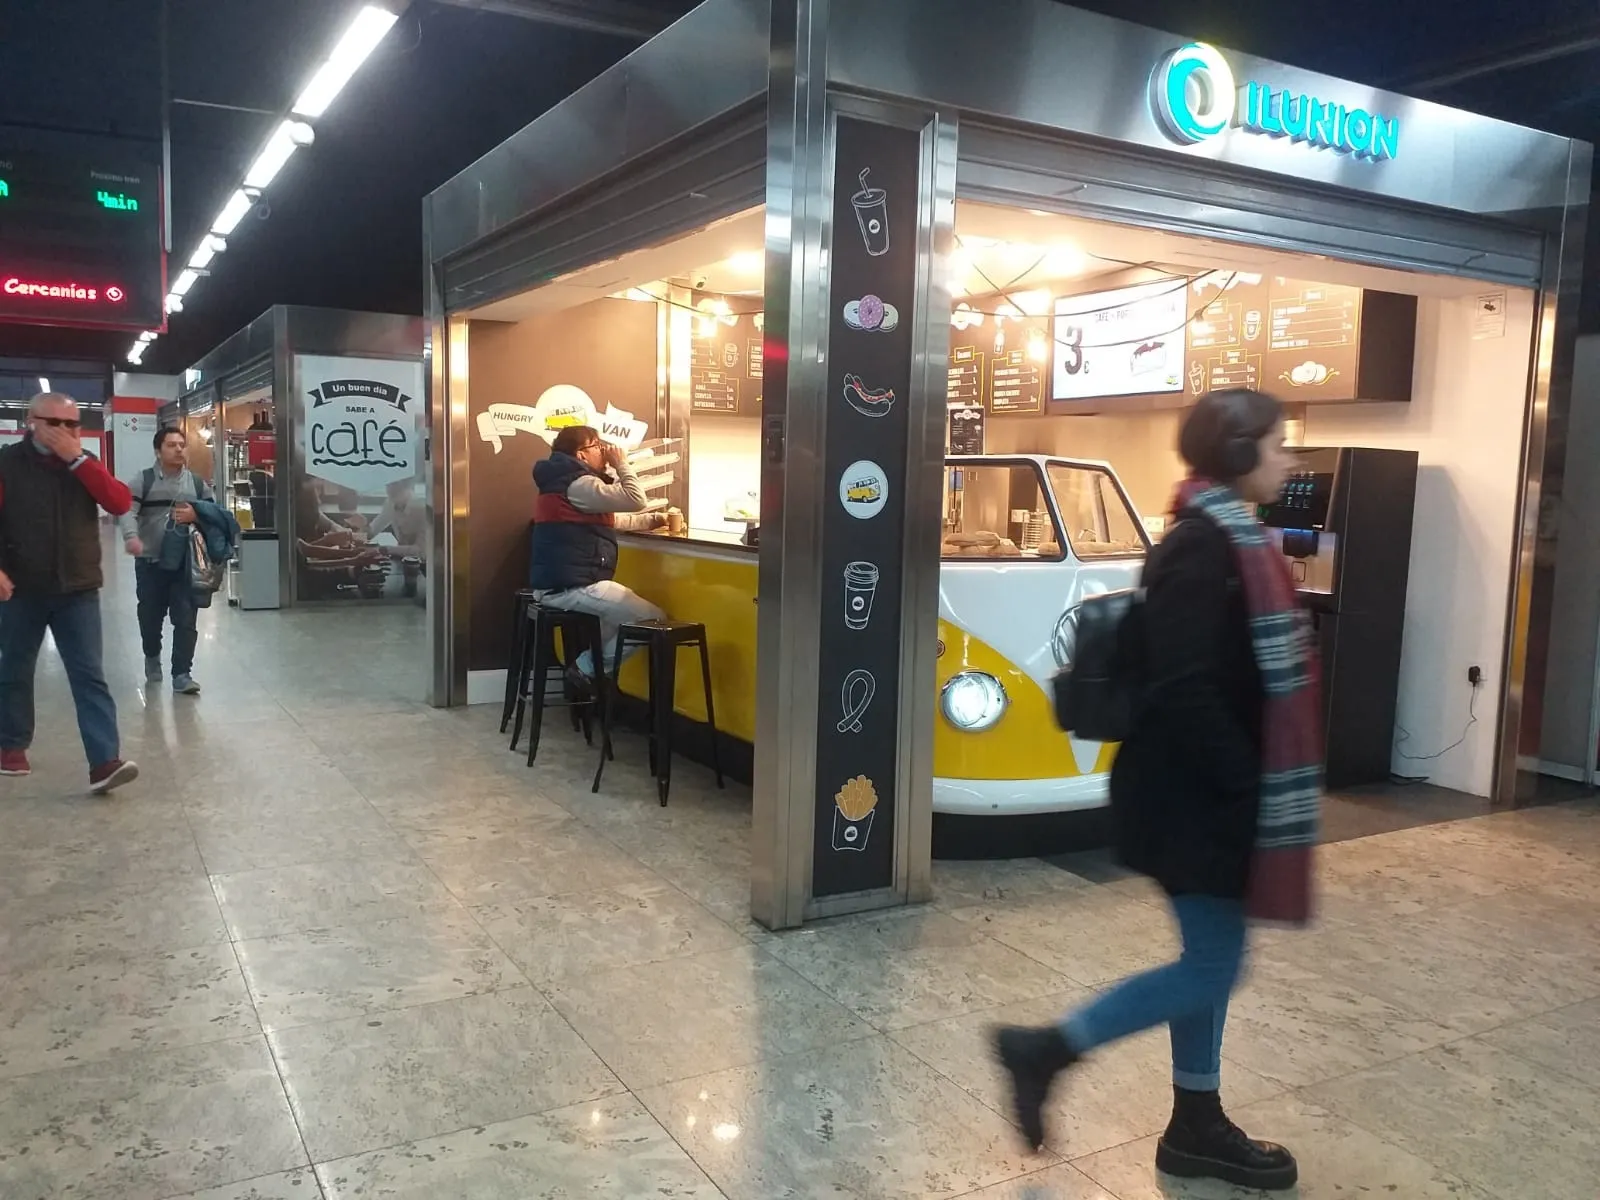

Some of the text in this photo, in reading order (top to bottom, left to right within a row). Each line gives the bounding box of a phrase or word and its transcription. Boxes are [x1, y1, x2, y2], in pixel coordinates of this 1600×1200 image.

[1247, 80, 1399, 160] ILUNION
[97, 190, 138, 210] 4min
[4, 278, 97, 300] Cercanías
[332, 384, 346, 393] Un
[348, 383, 371, 393] buen
[345, 405, 367, 413] SABE
[493, 411, 631, 439] HUNGRY VAN
[311, 419, 407, 459] café
